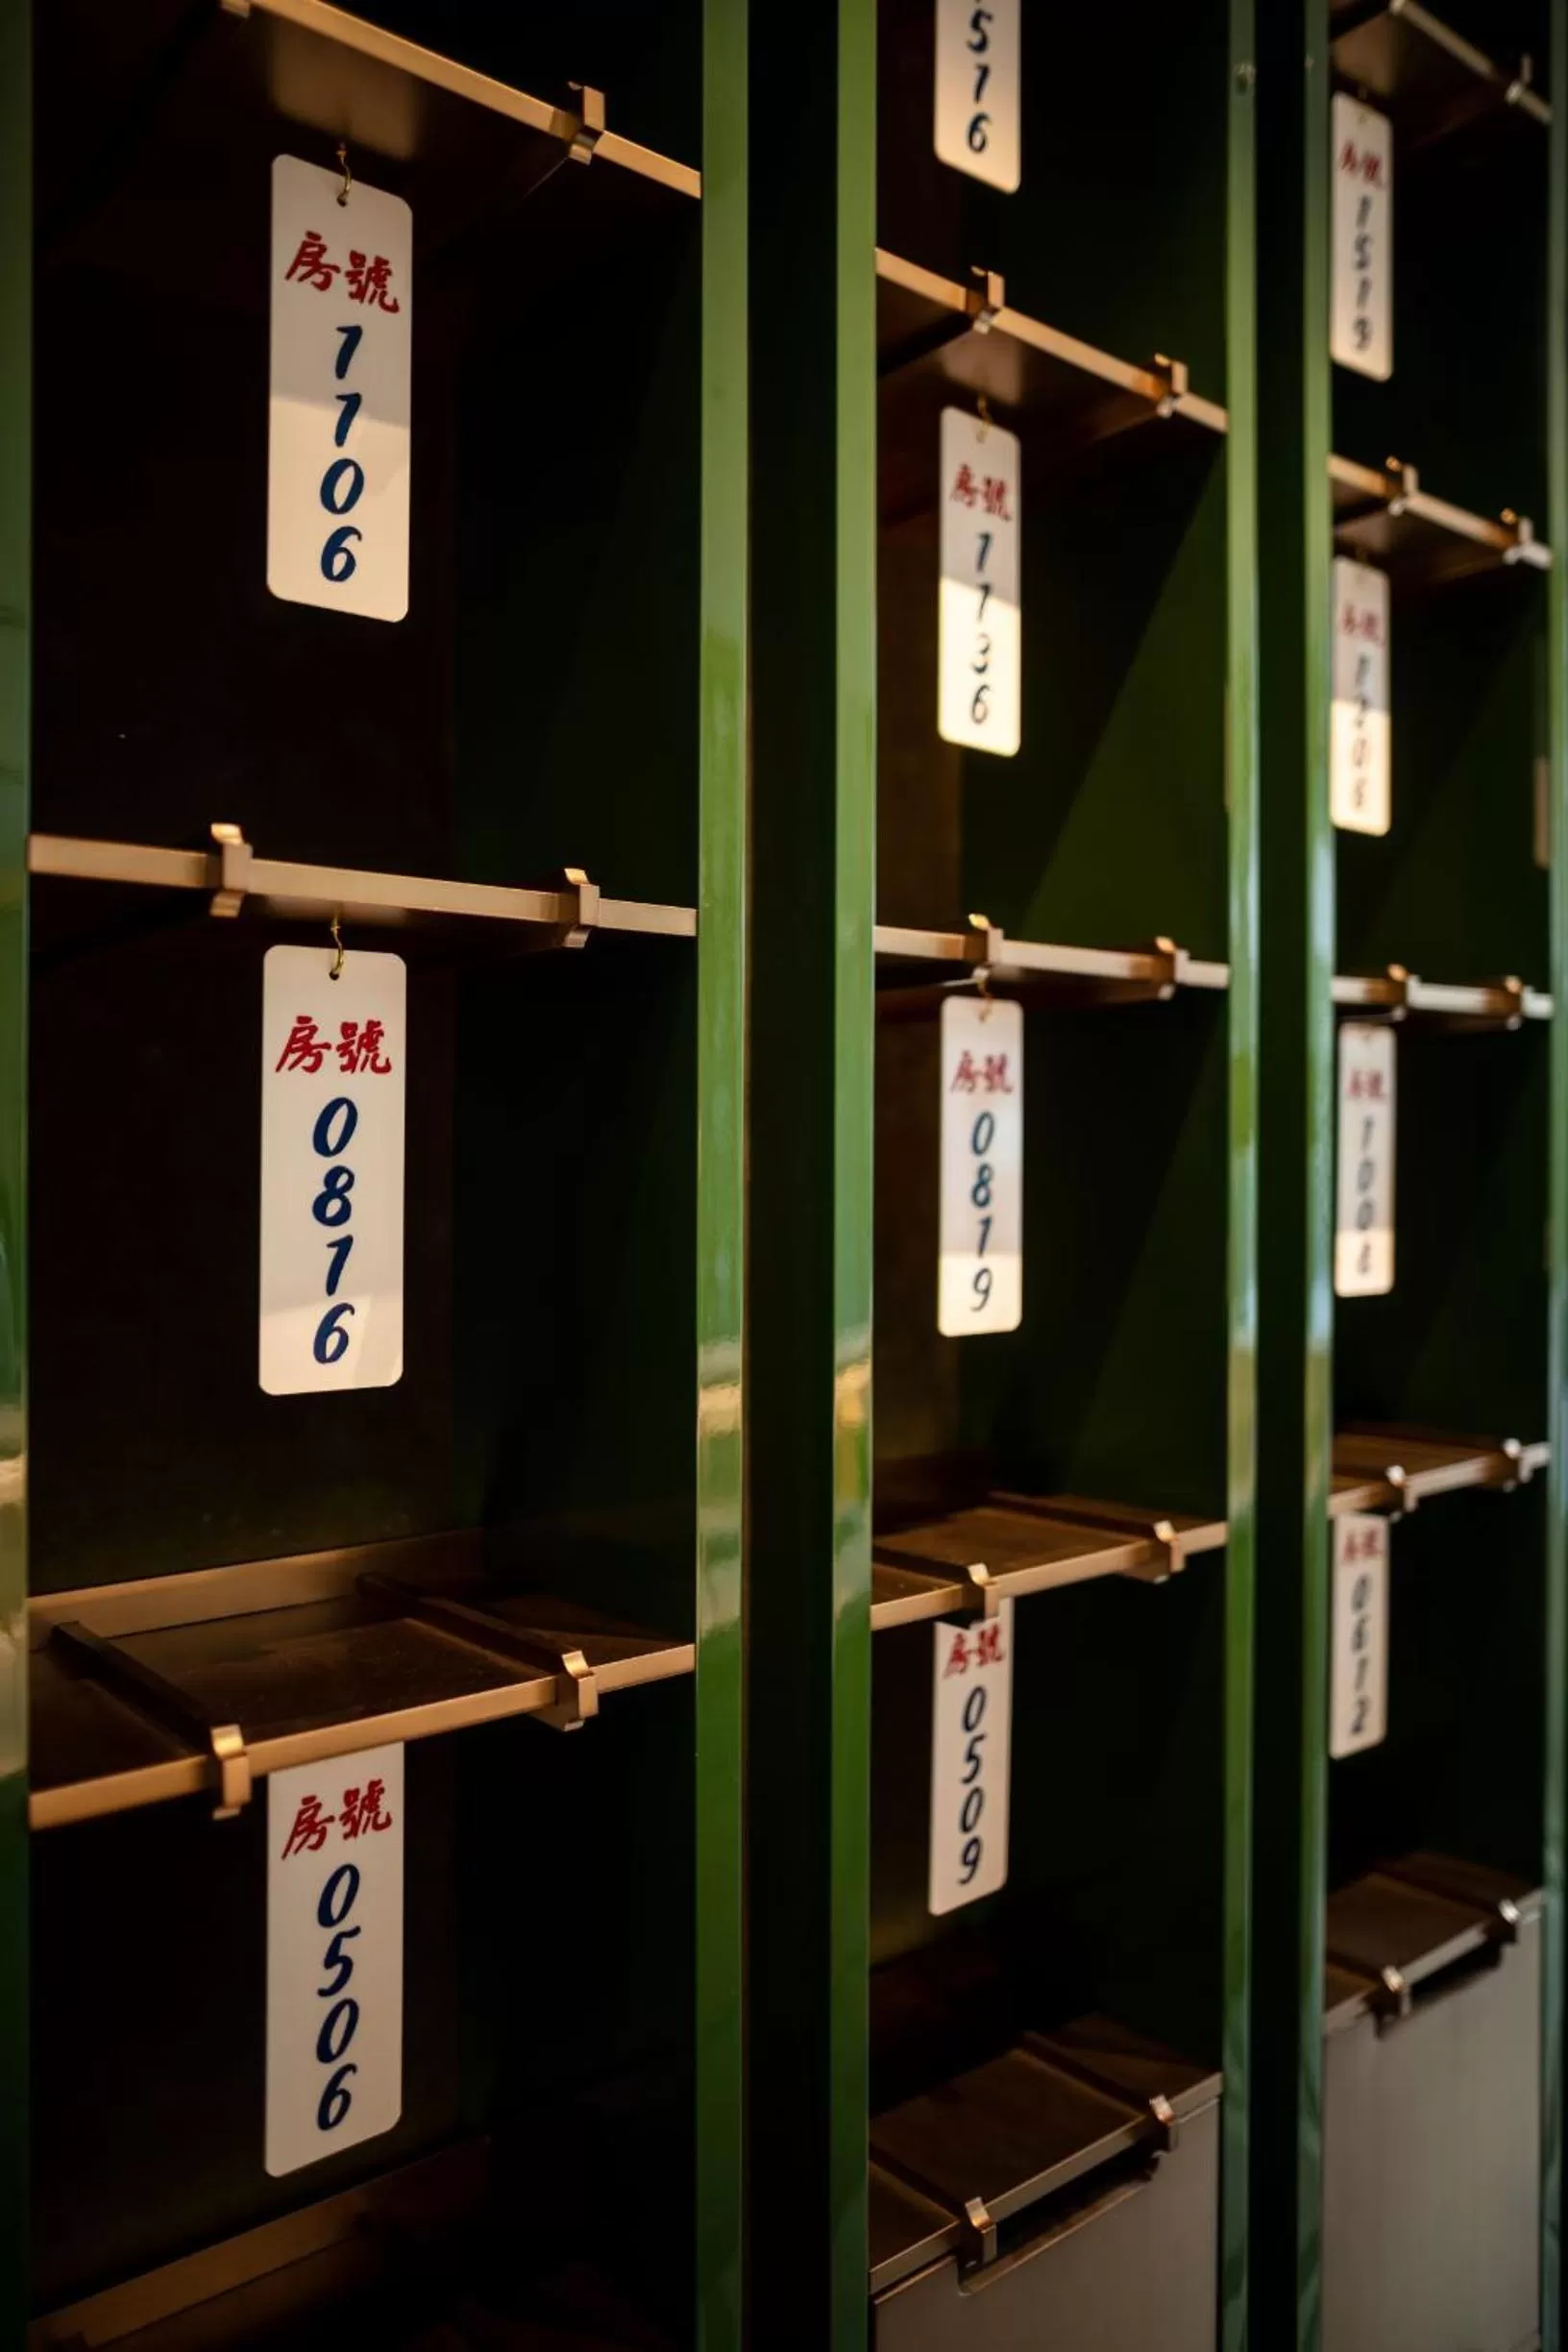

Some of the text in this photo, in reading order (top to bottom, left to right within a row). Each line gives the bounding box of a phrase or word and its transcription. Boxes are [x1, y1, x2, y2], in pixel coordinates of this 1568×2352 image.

[967, 0, 993, 154] 516
[284, 230, 401, 314] 房號
[319, 325, 365, 583] 1106
[949, 463, 1014, 523] 房號
[969, 531, 996, 724] 1136
[275, 1015, 392, 1075] 房號
[949, 1049, 1014, 1094] 房號
[311, 1096, 359, 1365] 0816
[969, 1111, 995, 1312] 0819
[943, 1620, 1007, 1679] 房號
[282, 1778, 394, 1860] 房號
[959, 1685, 990, 1887] 0509
[315, 1862, 363, 2133] 0506
